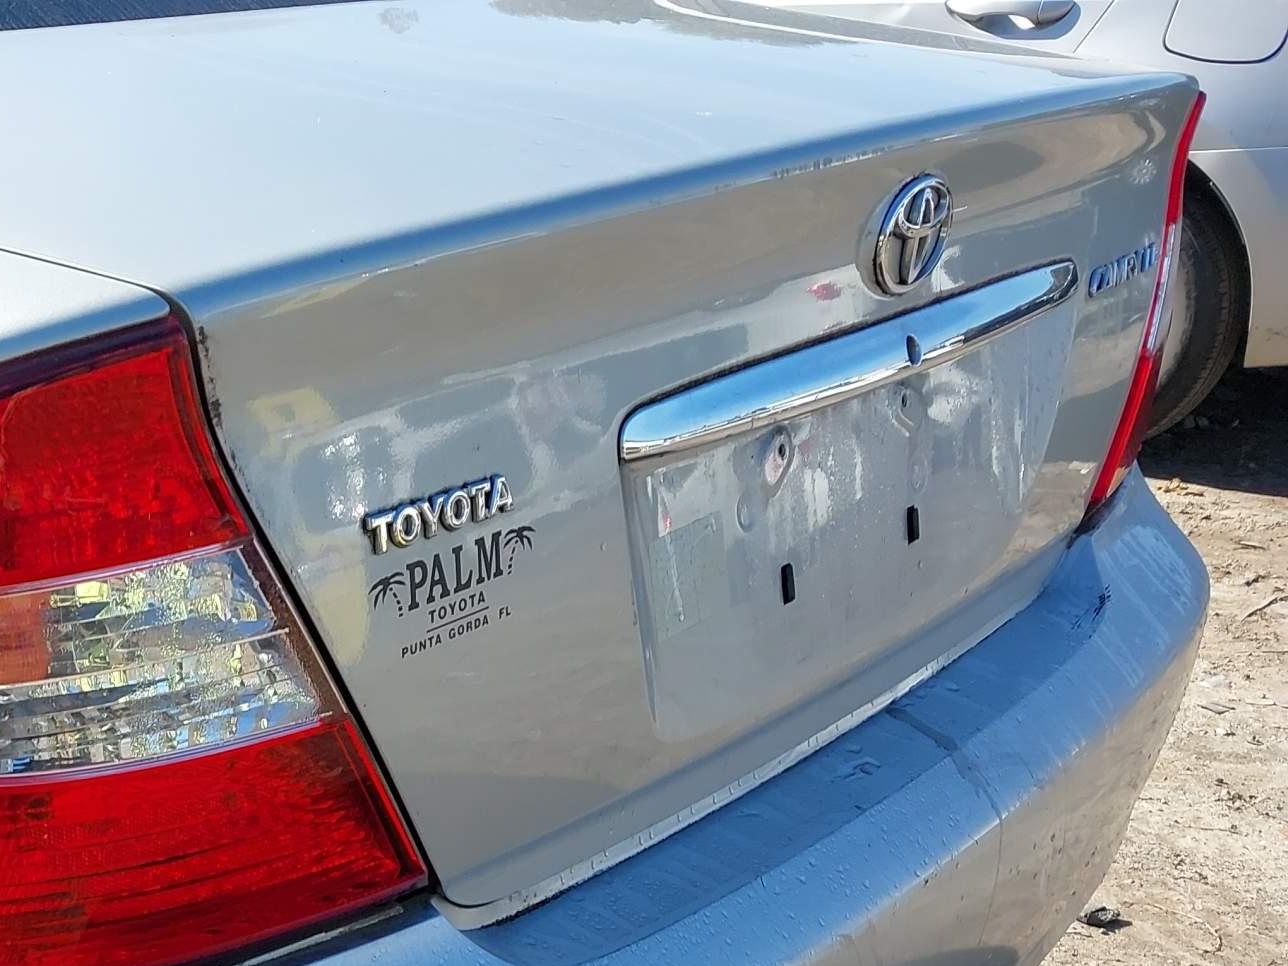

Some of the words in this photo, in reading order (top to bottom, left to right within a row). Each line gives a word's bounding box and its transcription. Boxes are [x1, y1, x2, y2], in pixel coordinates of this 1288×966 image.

[363, 474, 515, 554] TOYOTA
[406, 529, 504, 612] PALM
[401, 633, 442, 658] PUNTA
[448, 614, 489, 640] GORDA
[498, 605, 511, 619] FL
[428, 591, 486, 624] TOYOTA
